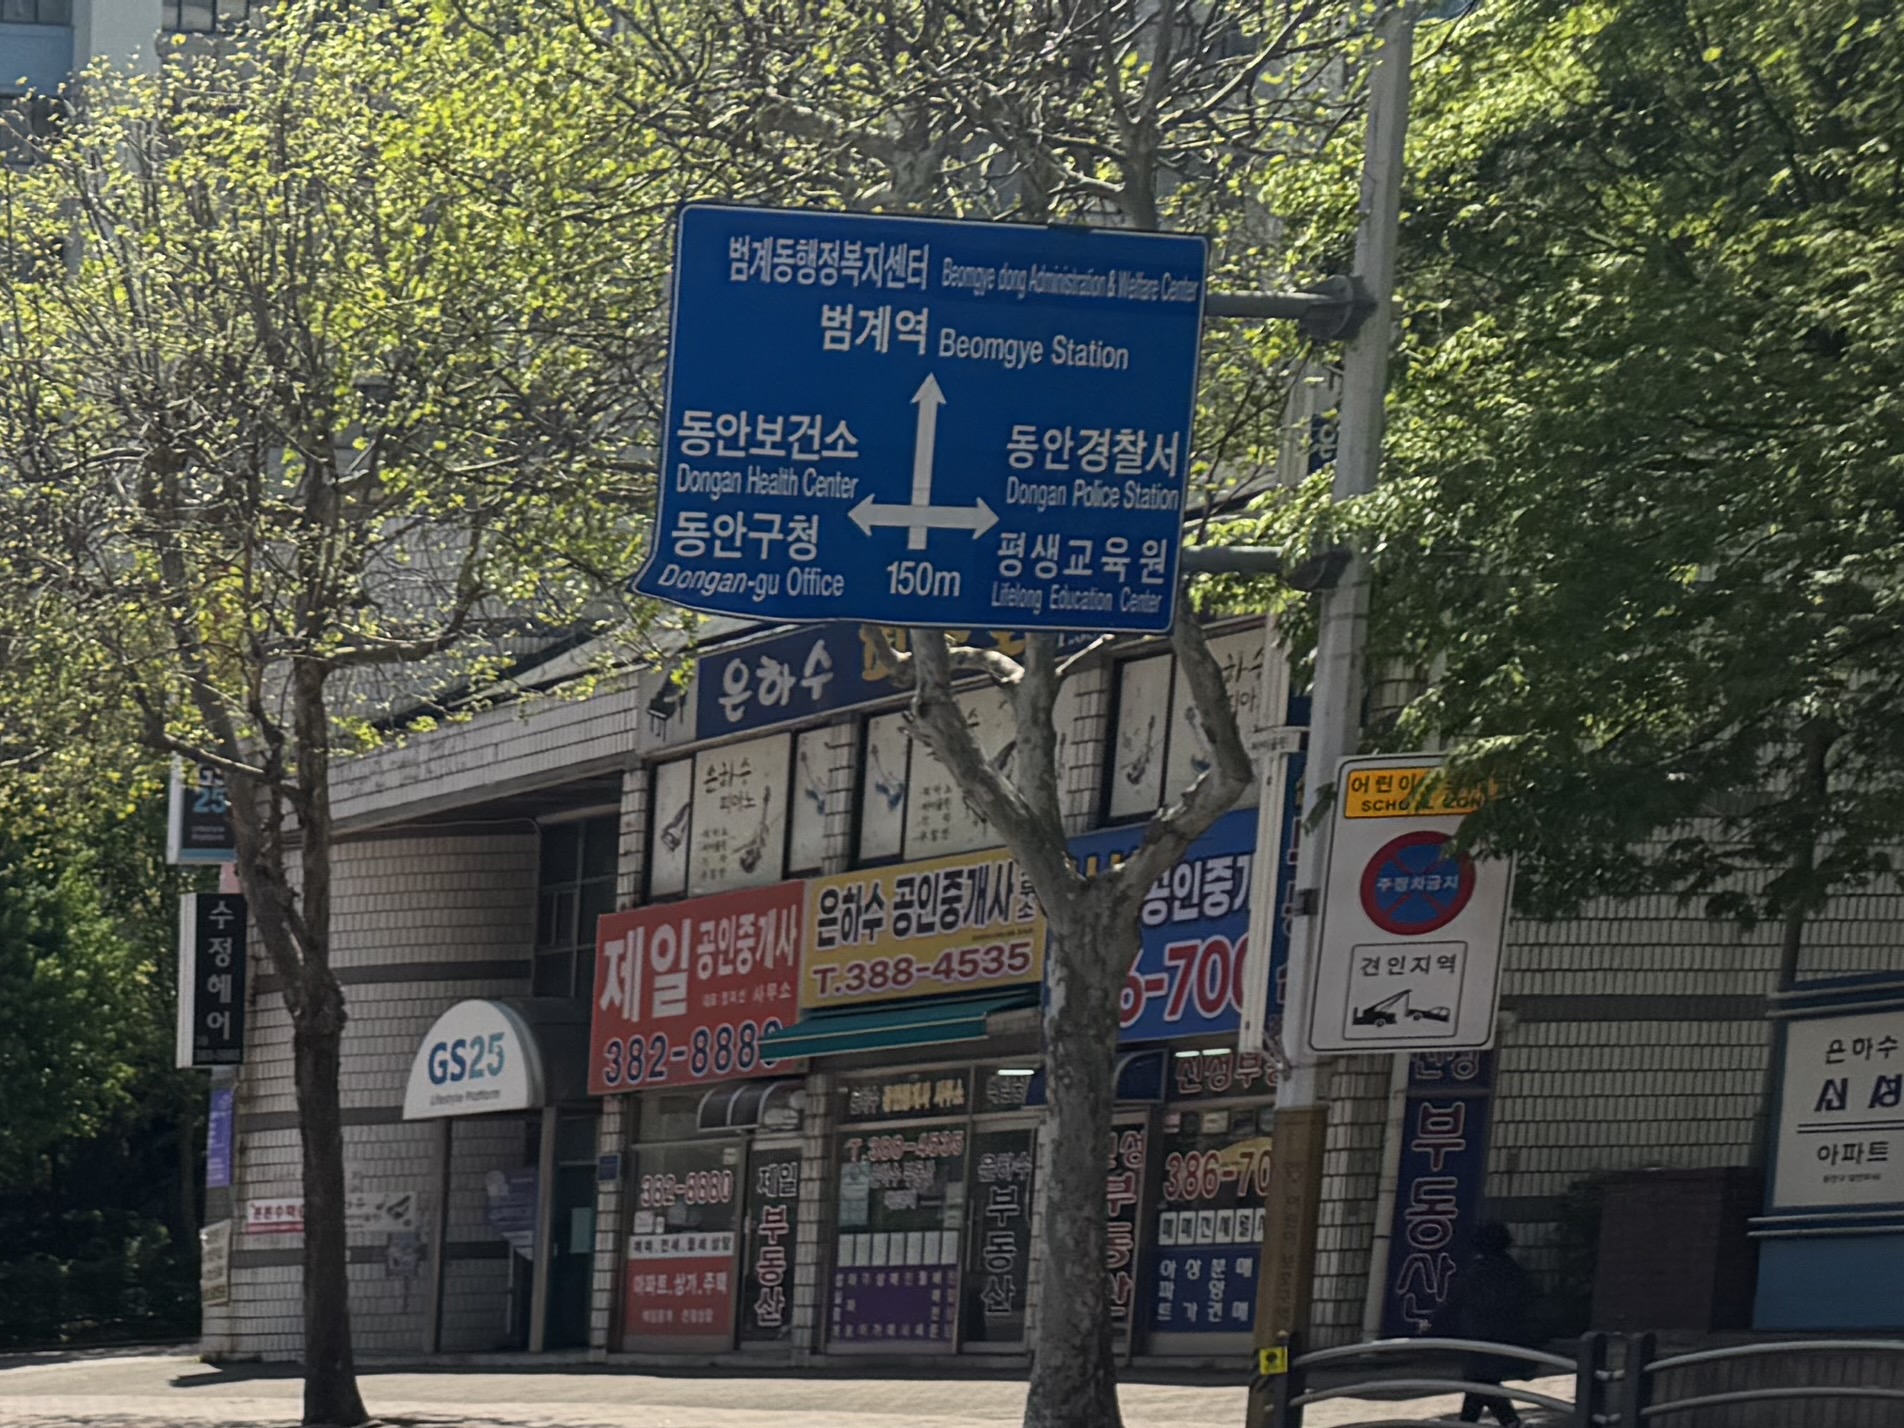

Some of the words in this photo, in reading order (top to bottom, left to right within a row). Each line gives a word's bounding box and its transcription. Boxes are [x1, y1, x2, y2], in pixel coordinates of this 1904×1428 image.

[729, 236, 929, 290] 범계동행정복지센터
[941, 257, 995, 295] Beomgye
[998, 261, 1026, 298] dong
[1029, 263, 1106, 297] Administration
[1107, 270, 1116, 297] &
[1118, 271, 1158, 300] Welfare
[1161, 273, 1199, 303] Center
[821, 304, 929, 355] 범계역
[939, 328, 1043, 370] Beomgye
[1051, 338, 1129, 370] Station
[677, 410, 859, 461] 동안보건소
[1006, 424, 1180, 478] 동안경찰서
[676, 463, 742, 500] Dongan
[746, 466, 798, 496] Health
[802, 467, 859, 499] Center
[1006, 476, 1067, 512] Dongan
[1072, 478, 1120, 509] Police
[1122, 480, 1179, 510] Station
[671, 511, 820, 562] 동안구청
[997, 532, 1167, 584] 평생교육원
[658, 564, 780, 602] Dongan-gu
[786, 567, 844, 596] Office
[886, 561, 961, 597] 150m
[991, 581, 1042, 615] Lifelong
[1050, 584, 1112, 612] Education
[1119, 586, 1162, 613] Center
[718, 639, 834, 722] 은하수
[193, 788, 227, 814] 25
[816, 882, 885, 949] 은하수
[892, 860, 1017, 939] 공인중개사
[1377, 874, 1459, 892] 주정차금지
[206, 900, 235, 1041] 수정헤어
[600, 918, 692, 1023] 제일
[696, 904, 797, 980] 공인중개사
[813, 941, 1032, 996] T.388-4535
[1360, 954, 1457, 977] 견인지역
[428, 1032, 505, 1085] GS25
[1825, 1035, 1899, 1064] 은하수
[1814, 1073, 1904, 1112] 신성
[1817, 1140, 1889, 1166] 아파트
[756, 1162, 797, 1198] 제일
[1396, 1101, 1466, 1323] 부동산
[754, 1205, 789, 1327] 부동산
[980, 1185, 1020, 1317] 부동산
